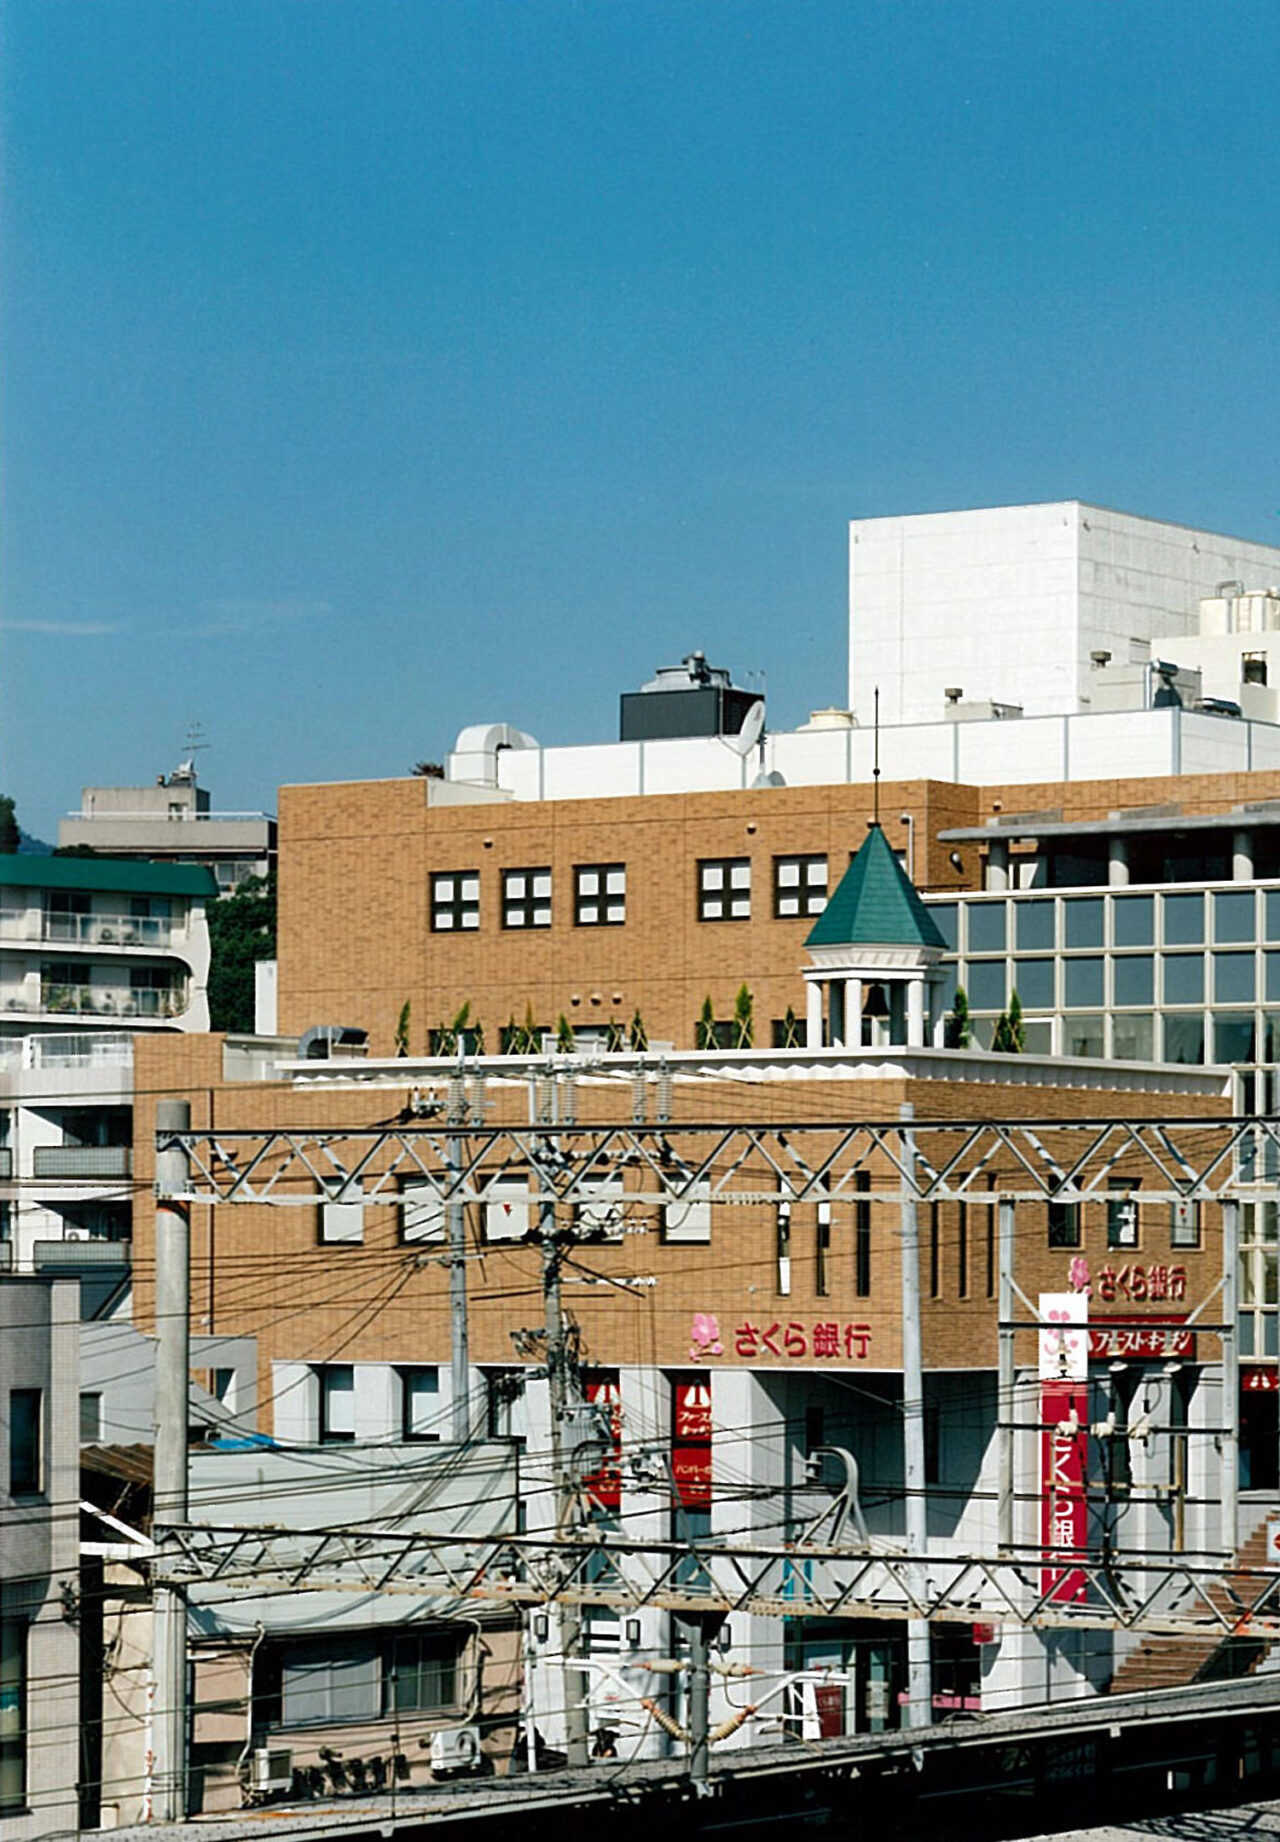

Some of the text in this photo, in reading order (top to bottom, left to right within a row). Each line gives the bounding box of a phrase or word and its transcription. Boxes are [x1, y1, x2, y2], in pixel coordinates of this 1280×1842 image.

[1097, 1264, 1187, 1301] さくら銀行
[734, 1321, 873, 1359] さくら銀行
[1049, 1430, 1076, 1581] くら銀
